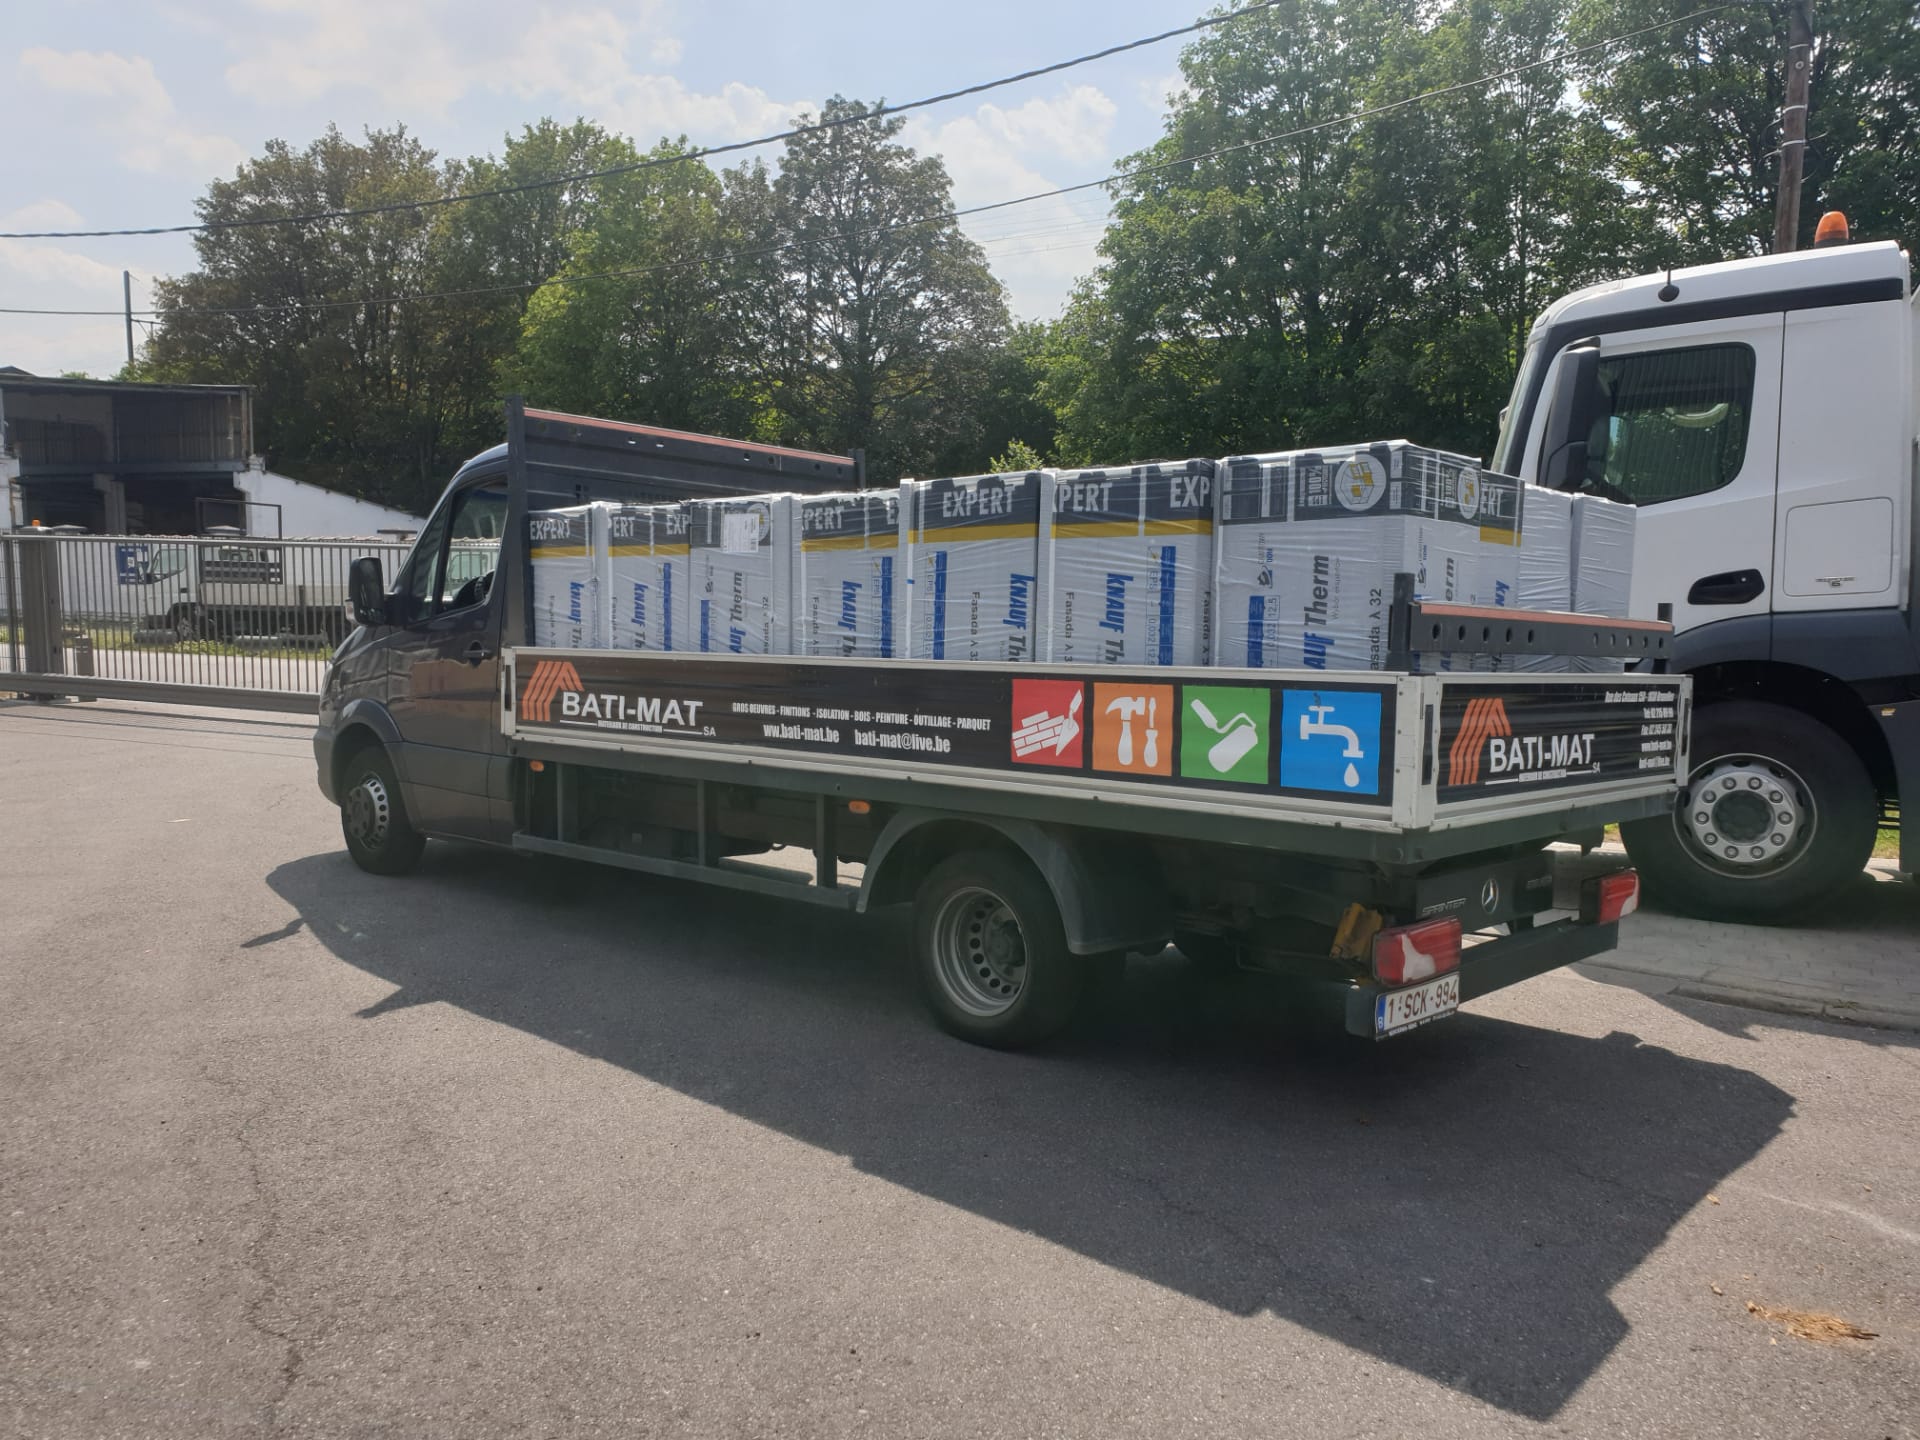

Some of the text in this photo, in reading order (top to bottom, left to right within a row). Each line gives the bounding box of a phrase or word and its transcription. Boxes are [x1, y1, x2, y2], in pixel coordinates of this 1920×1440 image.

[942, 484, 1013, 518] EXPERT
[1170, 475, 1210, 508] EXP
[530, 519, 571, 540] EXPERT
[802, 505, 845, 531] PERT
[729, 572, 743, 621] Therm
[1303, 555, 1330, 626] Therm
[1369, 588, 1382, 607] 32
[1064, 591, 1075, 639] Fasada
[562, 690, 704, 727] BATI-MAT
[732, 702, 749, 713] GROS
[749, 703, 776, 715] OEUVRES
[780, 705, 811, 718] FINITIONS
[816, 708, 850, 721] ISOLATION
[854, 710, 871, 722] BOIS
[876, 711, 909, 725] PEINTURE
[913, 714, 952, 728] OUTILLAGE
[956, 717, 992, 732] PARQUET
[703, 726, 717, 737] SA
[854, 729, 951, 753] bati-mat@live.be
[1489, 733, 1596, 773] BATI-MAT
